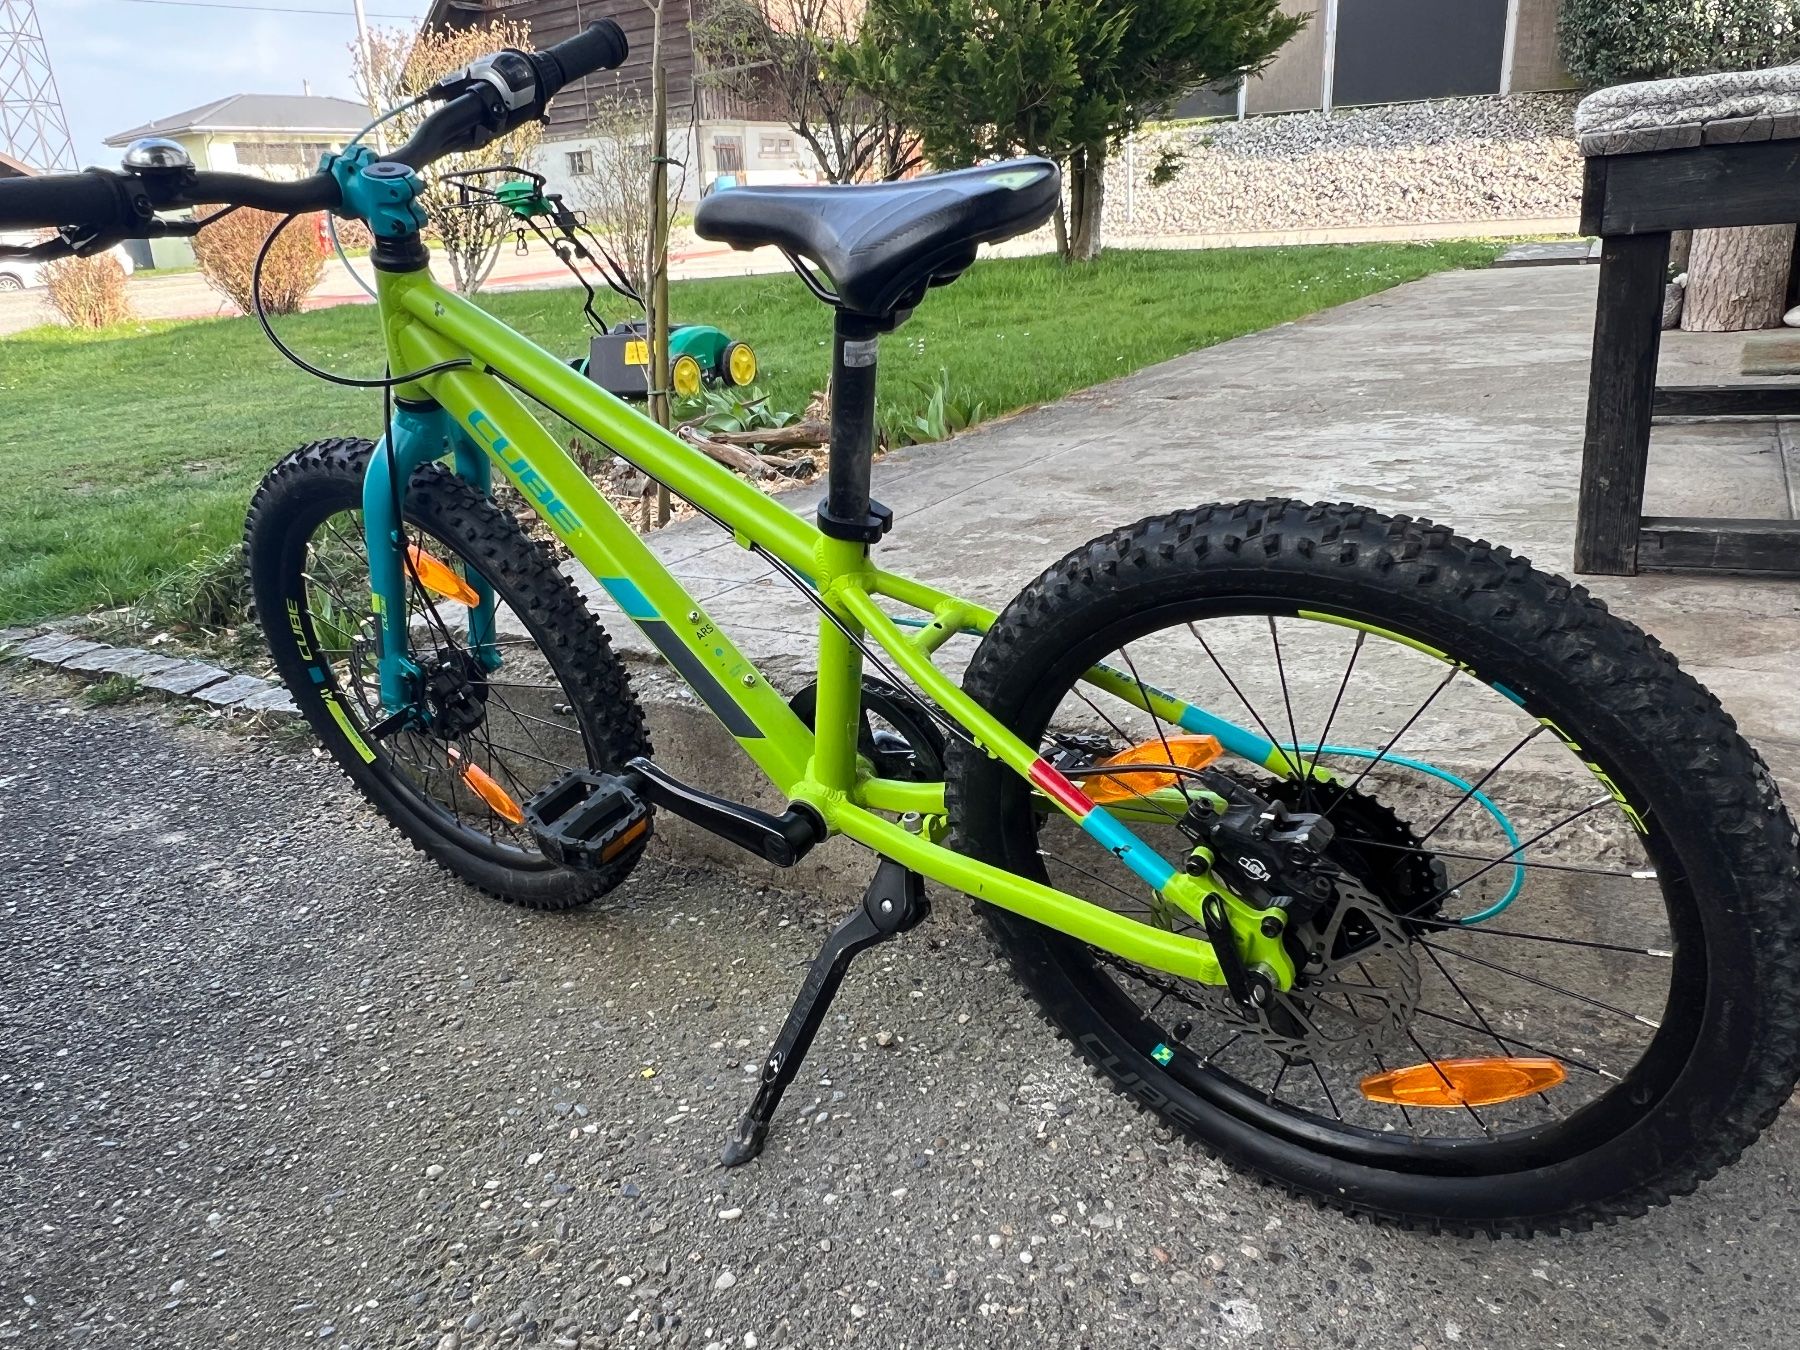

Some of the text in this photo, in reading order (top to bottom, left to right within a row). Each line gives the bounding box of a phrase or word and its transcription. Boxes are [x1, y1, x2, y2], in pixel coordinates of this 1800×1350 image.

[467, 408, 583, 535] CUBE
[286, 598, 313, 661] CUBE
[696, 624, 714, 640] ARS
[1079, 1033, 1201, 1132] CUBE
